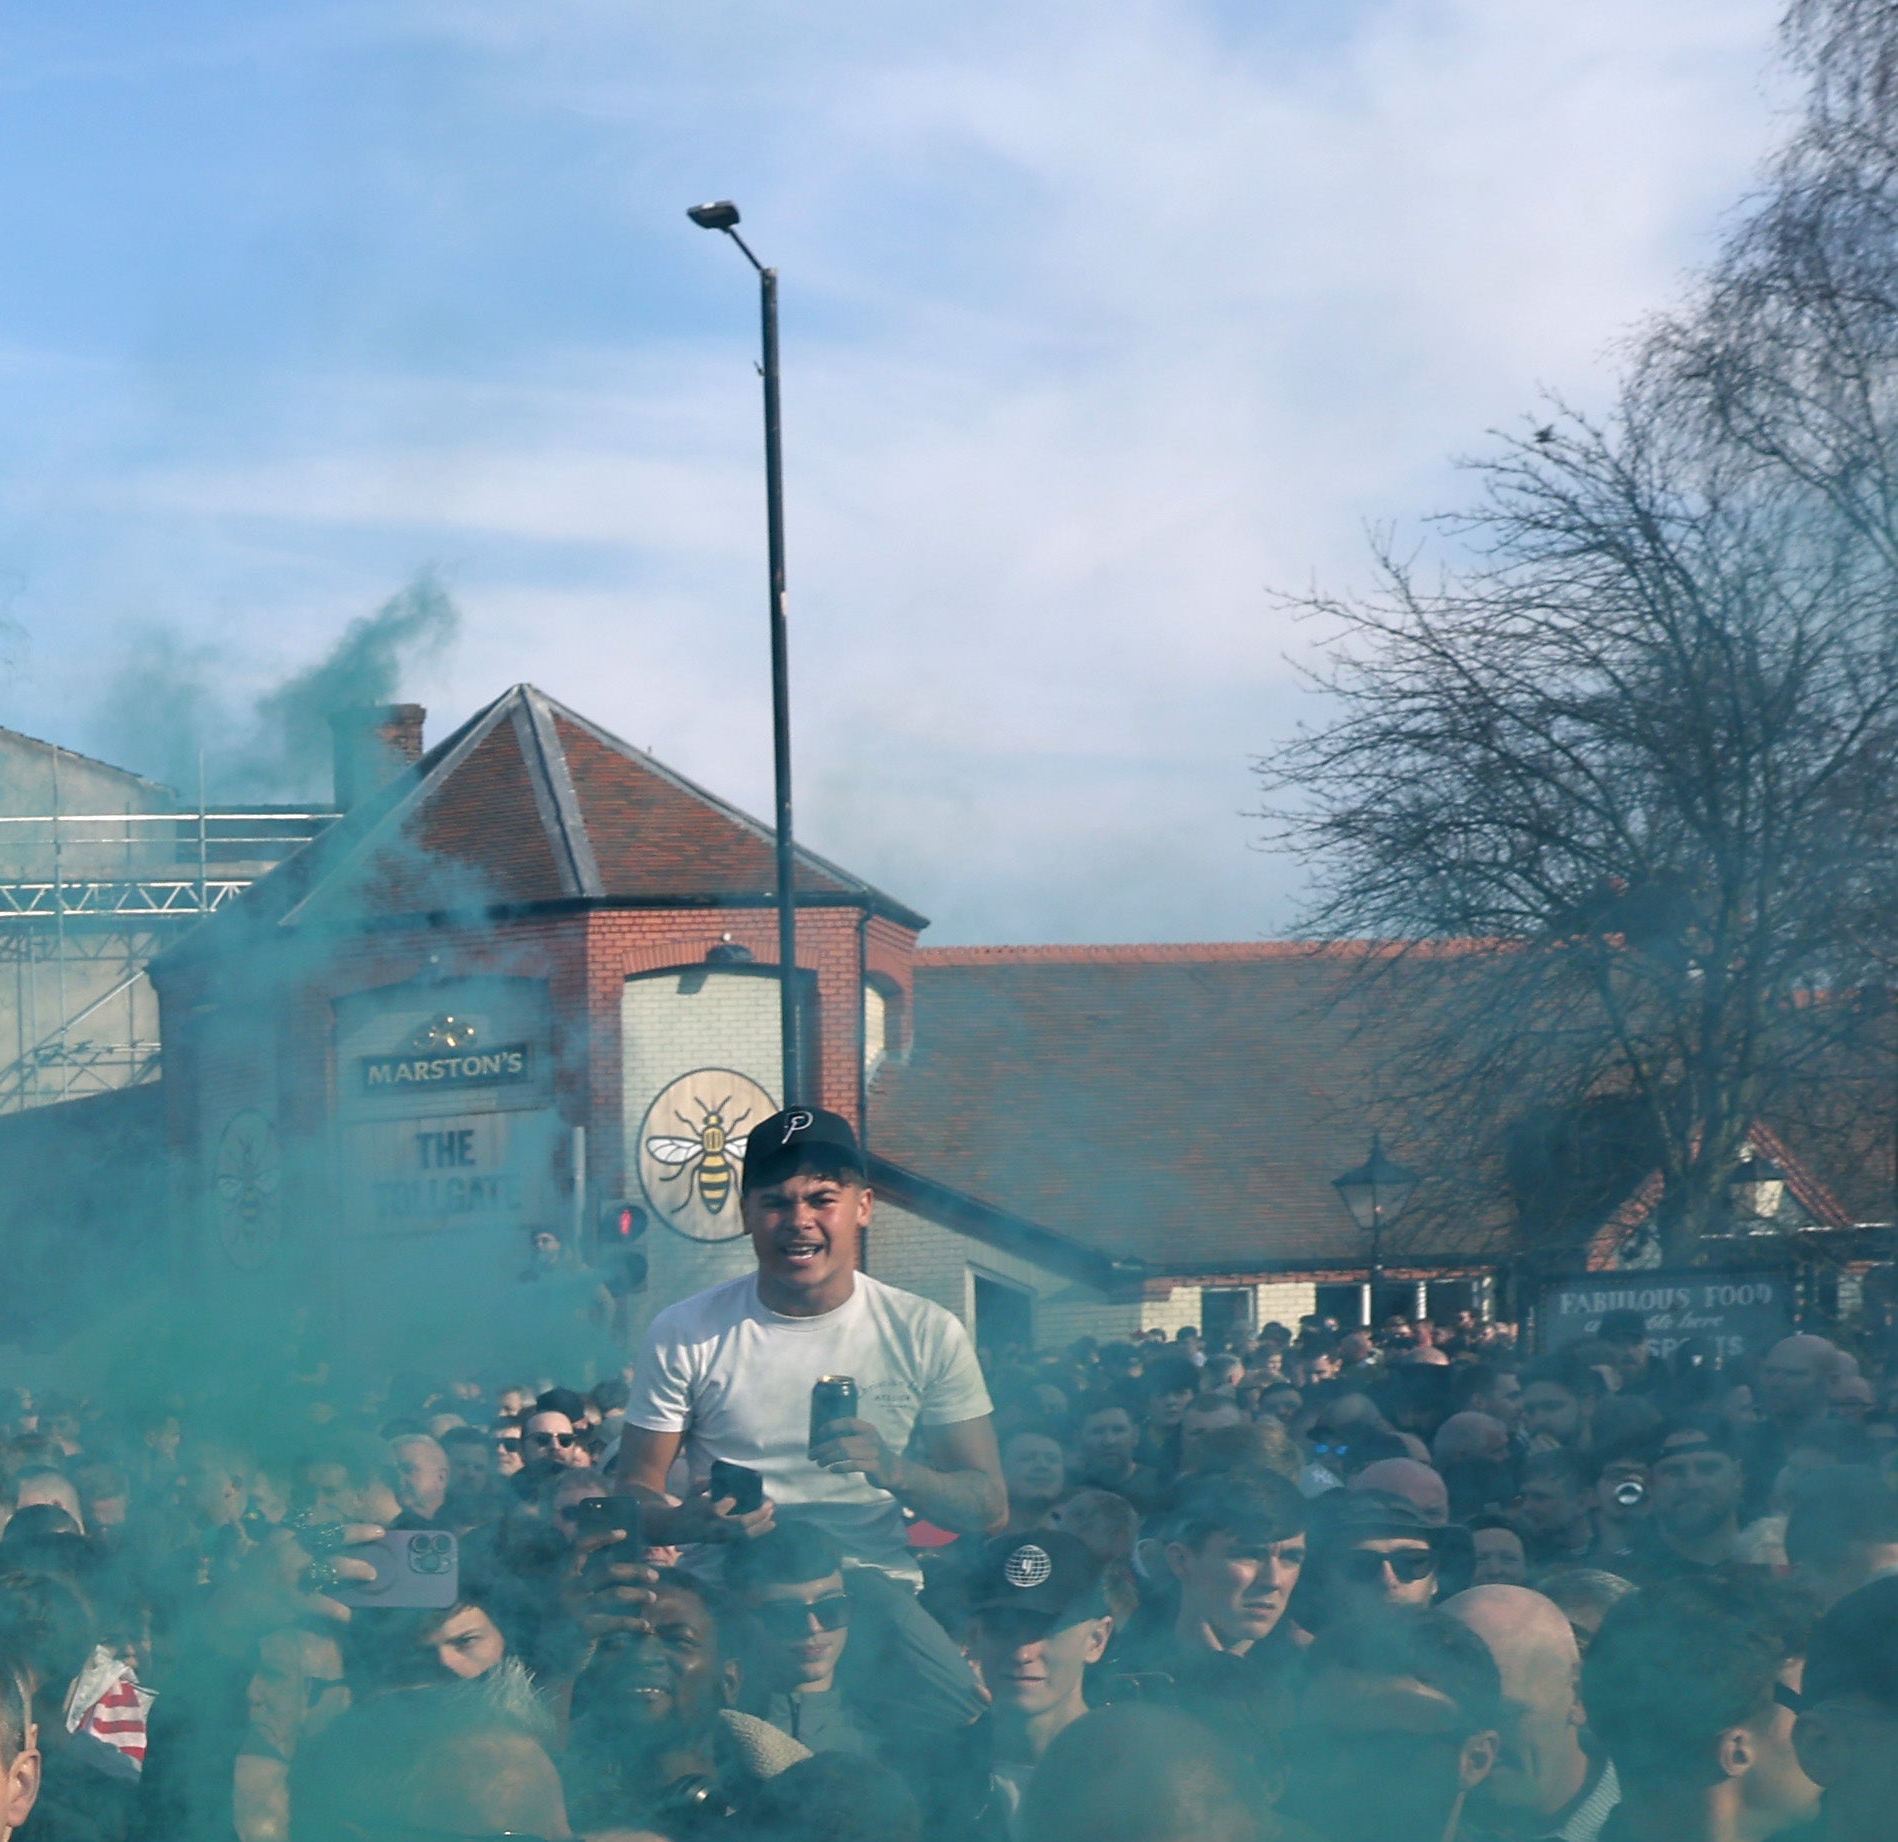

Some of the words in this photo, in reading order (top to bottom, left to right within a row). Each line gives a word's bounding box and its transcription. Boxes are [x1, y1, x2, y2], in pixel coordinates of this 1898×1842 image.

[368, 1051, 523, 1085] MARSTON'S
[414, 1129, 476, 1170] THE
[1559, 1288, 1691, 1315] FABULOUS
[1704, 1284, 1773, 1308] FOOD
